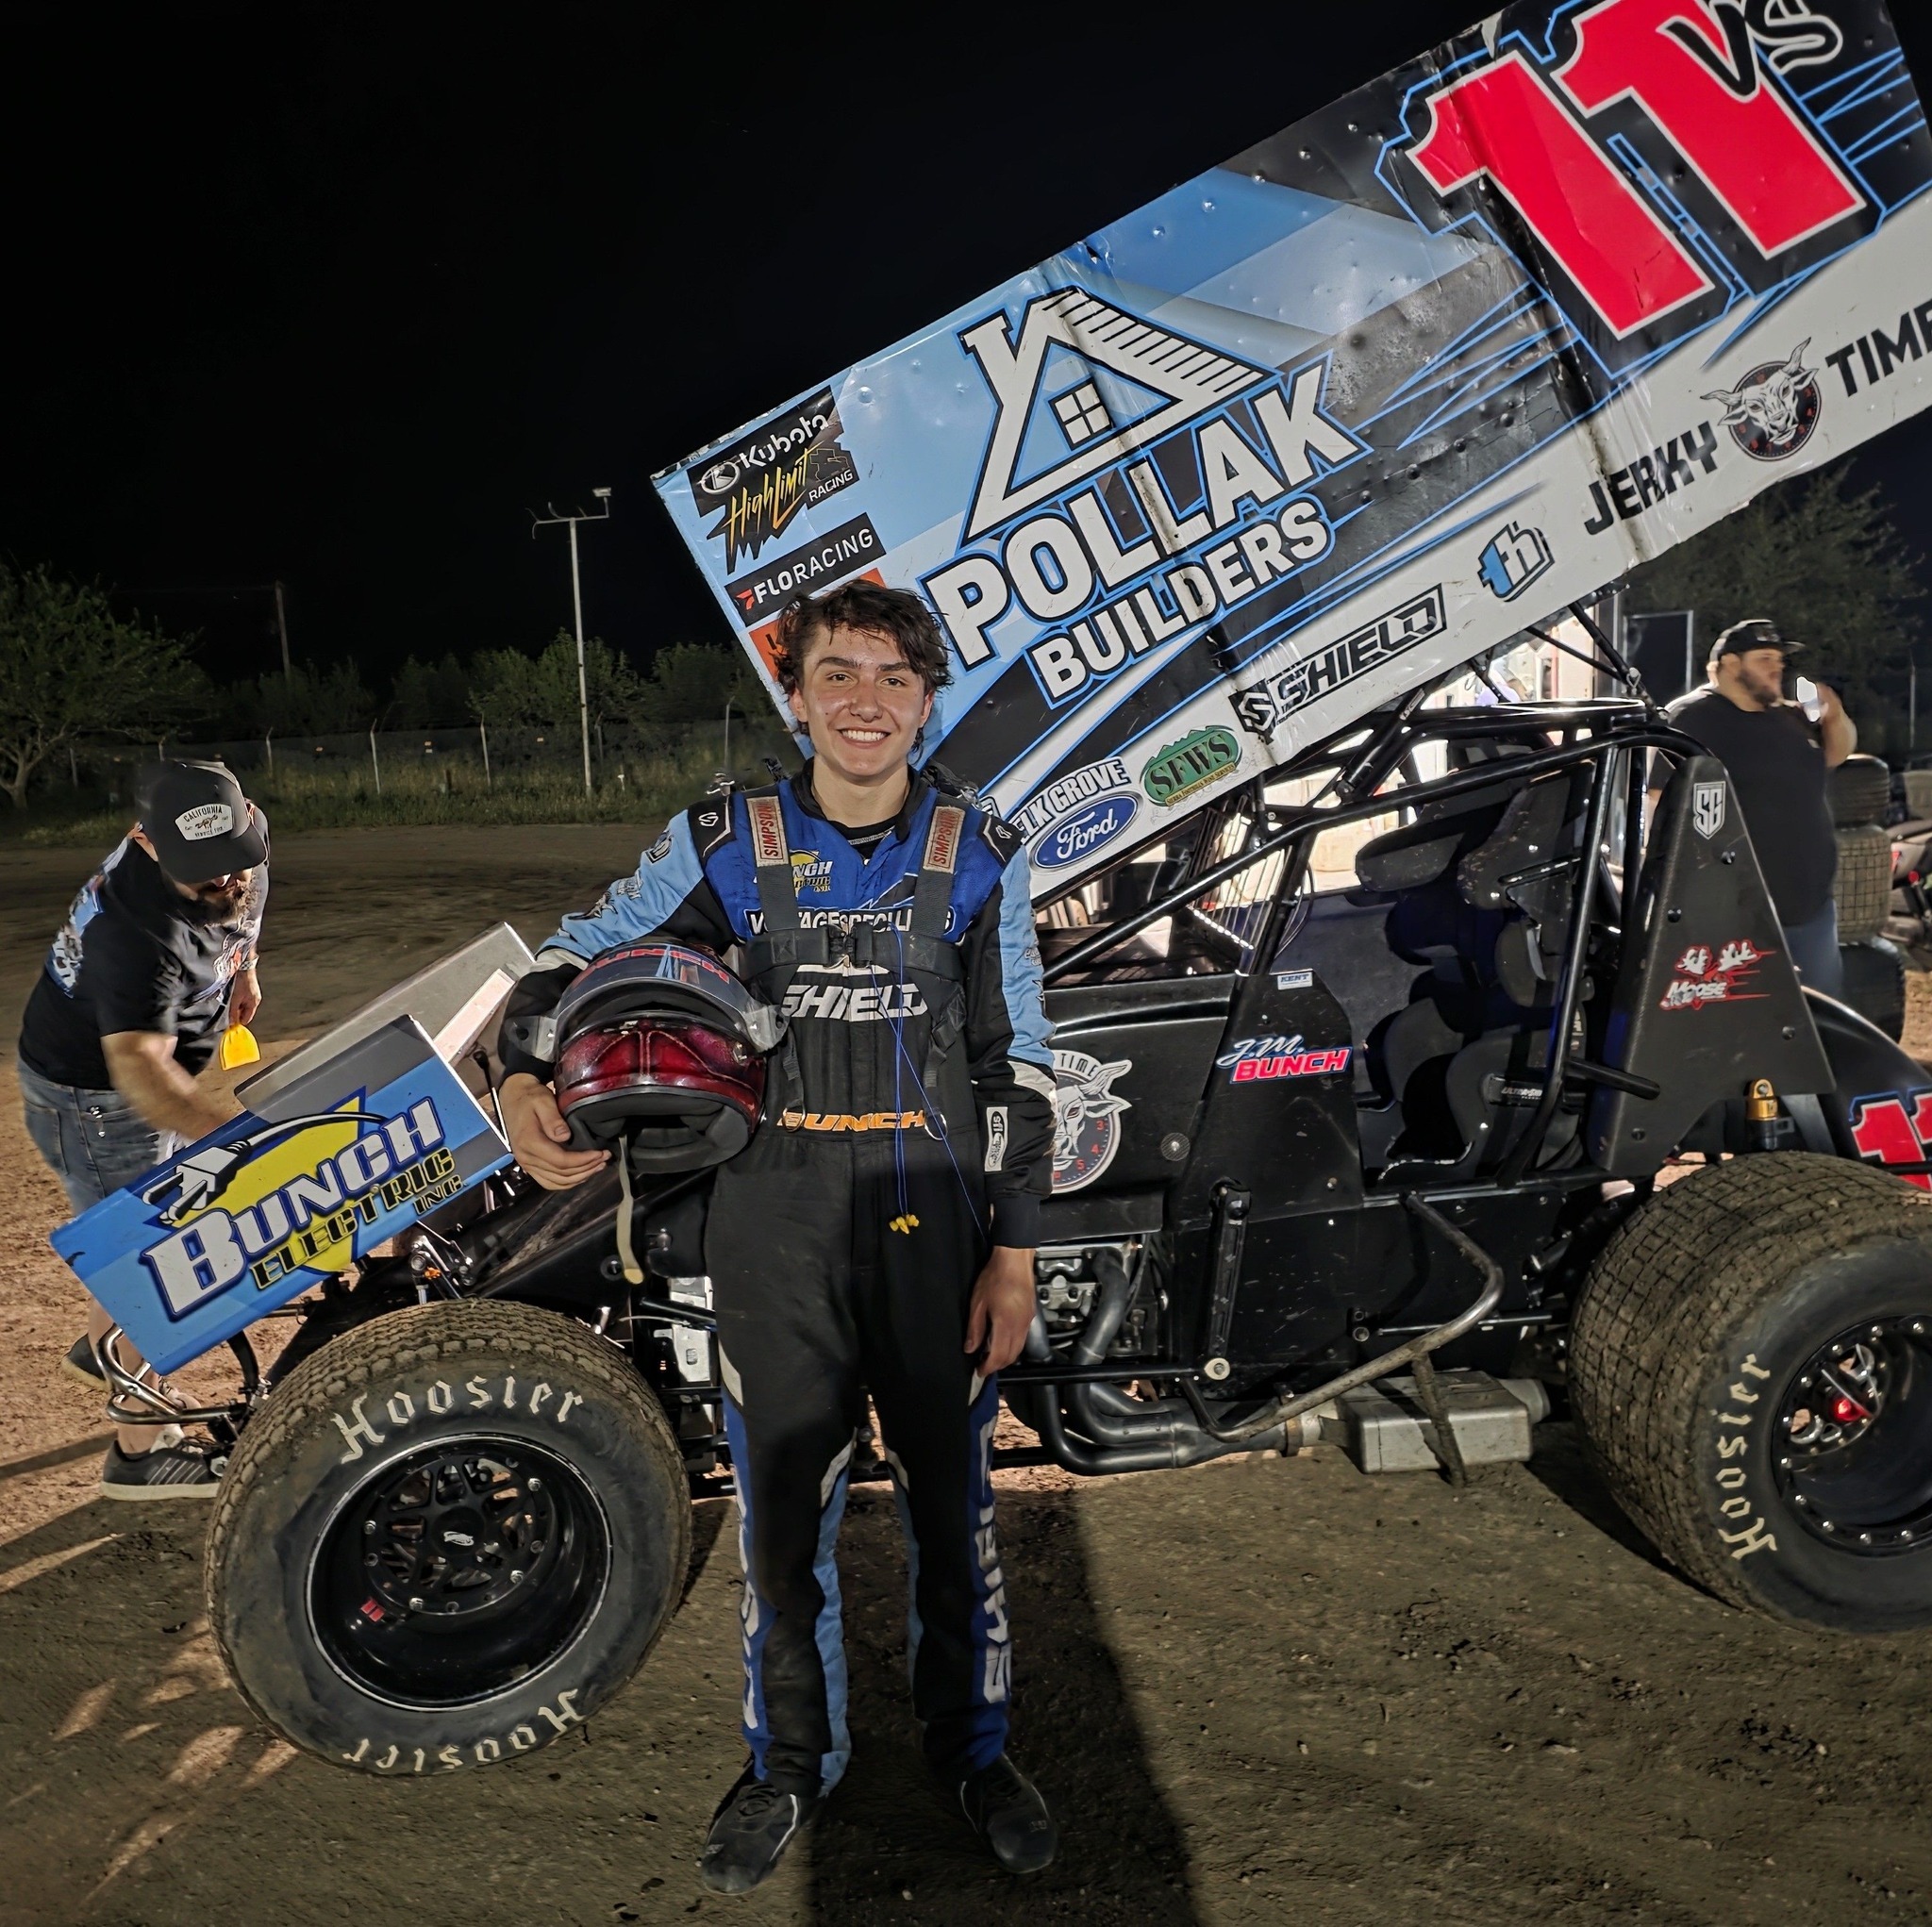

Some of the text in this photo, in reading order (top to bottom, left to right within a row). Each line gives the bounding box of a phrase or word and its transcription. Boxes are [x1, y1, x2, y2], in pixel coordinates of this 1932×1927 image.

[740, 414, 828, 468] Kubota
[808, 470, 853, 502] RACING
[1584, 421, 1718, 536] JERKY
[924, 363, 1361, 669] POLLAK
[1030, 498, 1328, 700] BUILDERS
[1277, 596, 1437, 713] SHIELD
[1048, 759, 1131, 811] GROVE
[1150, 733, 1231, 796] SFWS
[184, 806, 223, 822] CALIFORNIA
[758, 802, 779, 857] SIMPSON
[933, 809, 957, 865] SIMPSON
[1057, 808, 1118, 859] Ford
[792, 860, 834, 878] NCH
[781, 983, 928, 1022] SHIELD
[1281, 974, 1309, 983] KENT
[1060, 1053, 1097, 1077] TIME
[1232, 1049, 1350, 1082] BUNCH
[776, 1110, 927, 1132] BUNCH
[1091, 1144, 1101, 1155] 4
[141, 1098, 444, 1314] BUNCH
[249, 1146, 457, 1291] ELECTRIC
[333, 1375, 583, 1463] Hoosier
[1717, 1354, 1777, 1560] Hoosier
[343, 1688, 583, 1772] Hoosier
